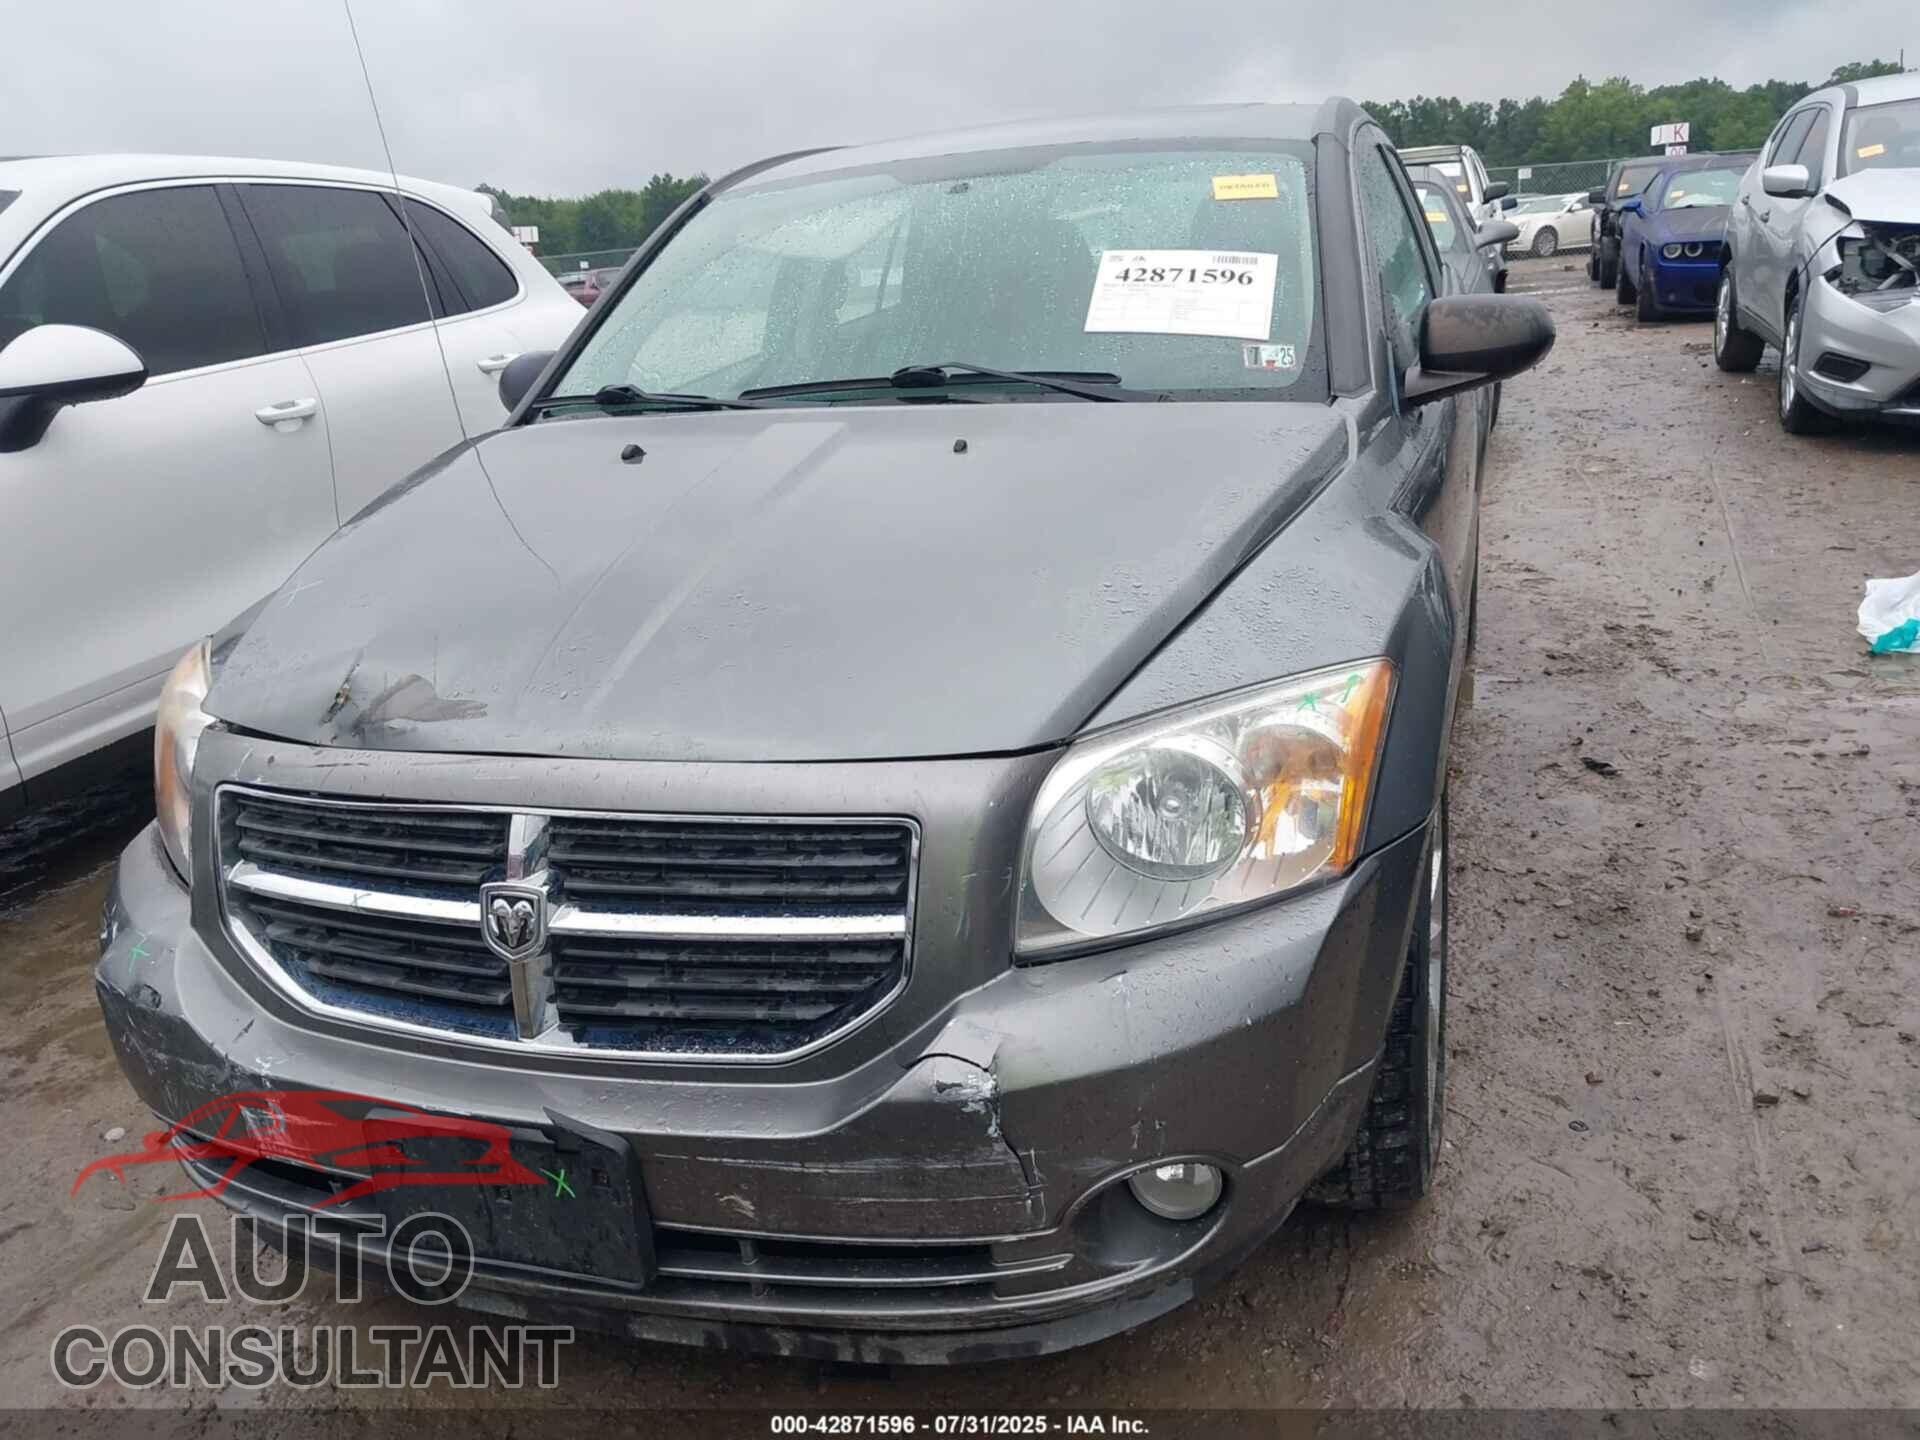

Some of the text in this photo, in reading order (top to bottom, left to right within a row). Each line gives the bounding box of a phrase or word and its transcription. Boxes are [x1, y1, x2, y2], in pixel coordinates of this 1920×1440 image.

[1674, 124, 1685, 143] K
[1115, 267, 1254, 285] 42871596
[1280, 347, 1294, 366] 25
